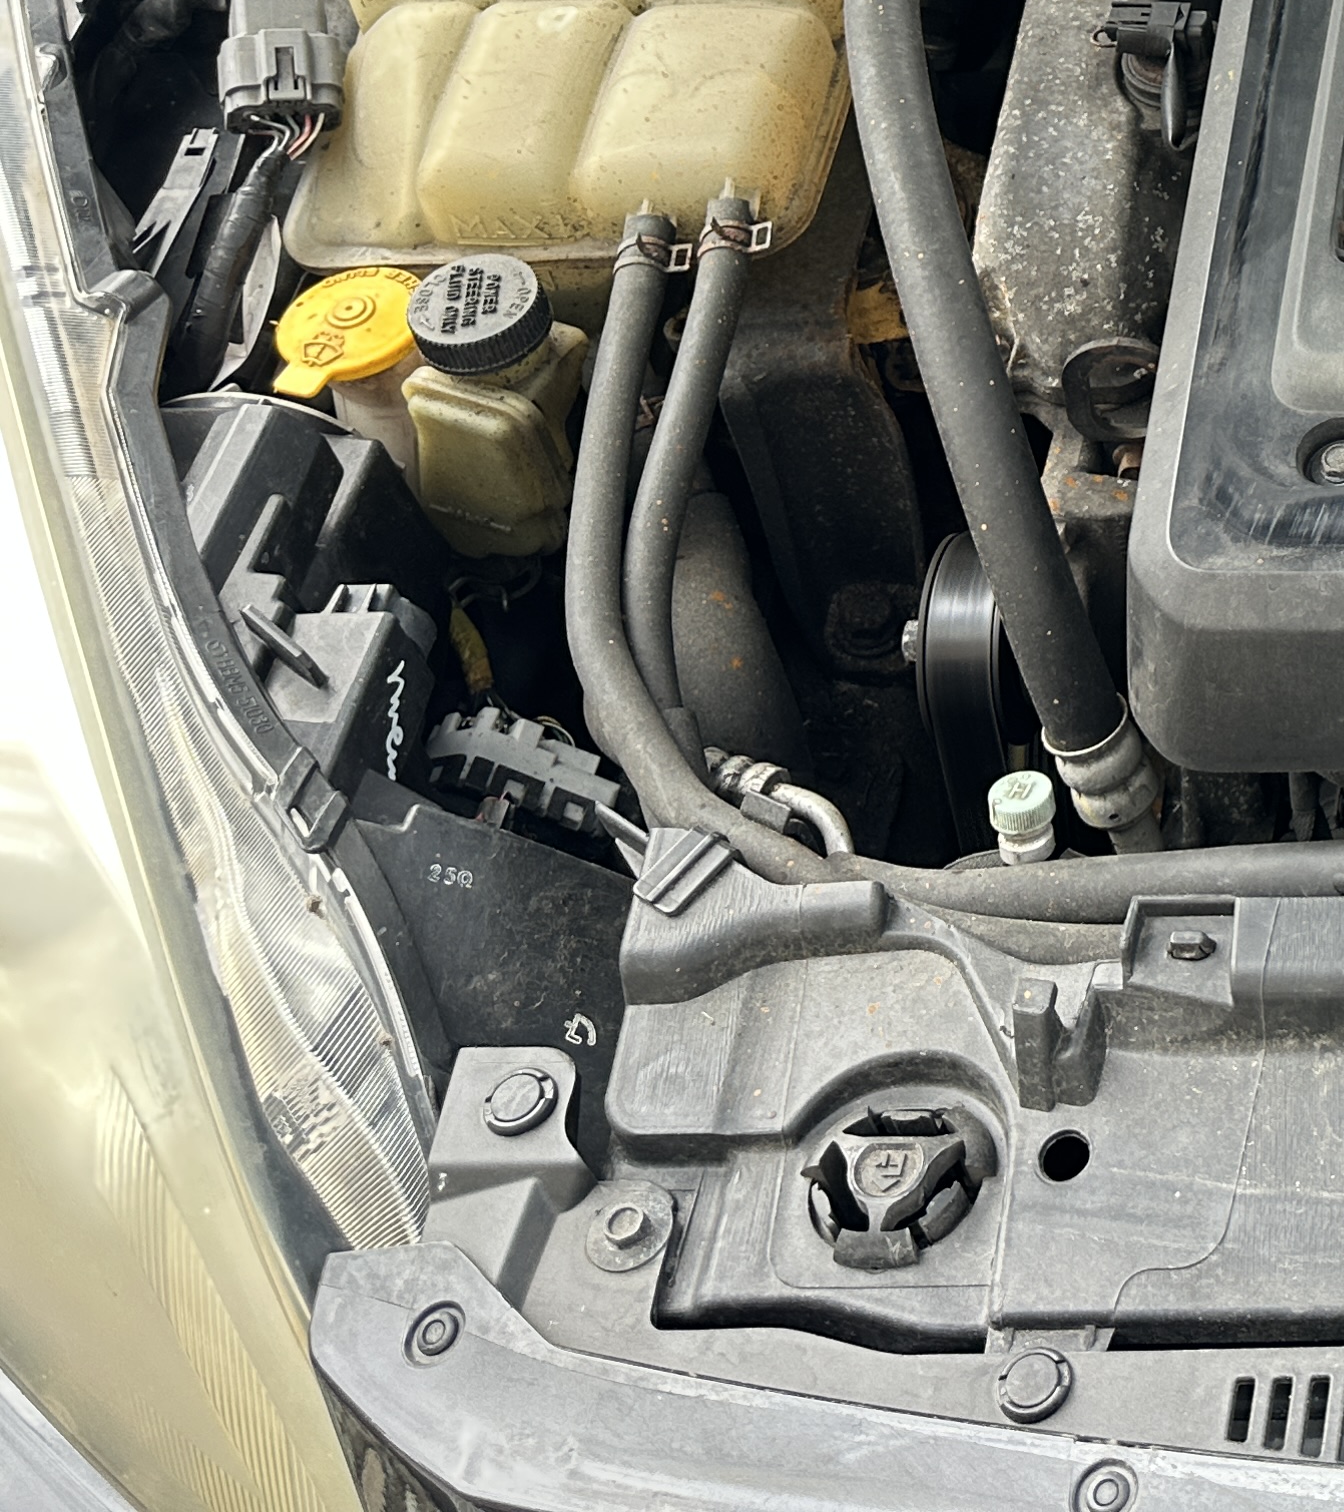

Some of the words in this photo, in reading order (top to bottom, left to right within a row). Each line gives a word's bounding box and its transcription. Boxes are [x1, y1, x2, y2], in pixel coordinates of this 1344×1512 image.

[450, 214, 551, 239] MAX
[413, 273, 447, 314] CLOSE
[446, 264, 466, 302] FLUID
[461, 267, 484, 328] STEERING
[481, 273, 502, 315] POWER
[441, 305, 459, 335] ONLY
[503, 288, 532, 319] OPEN
[1008, 781, 1034, 800] H
